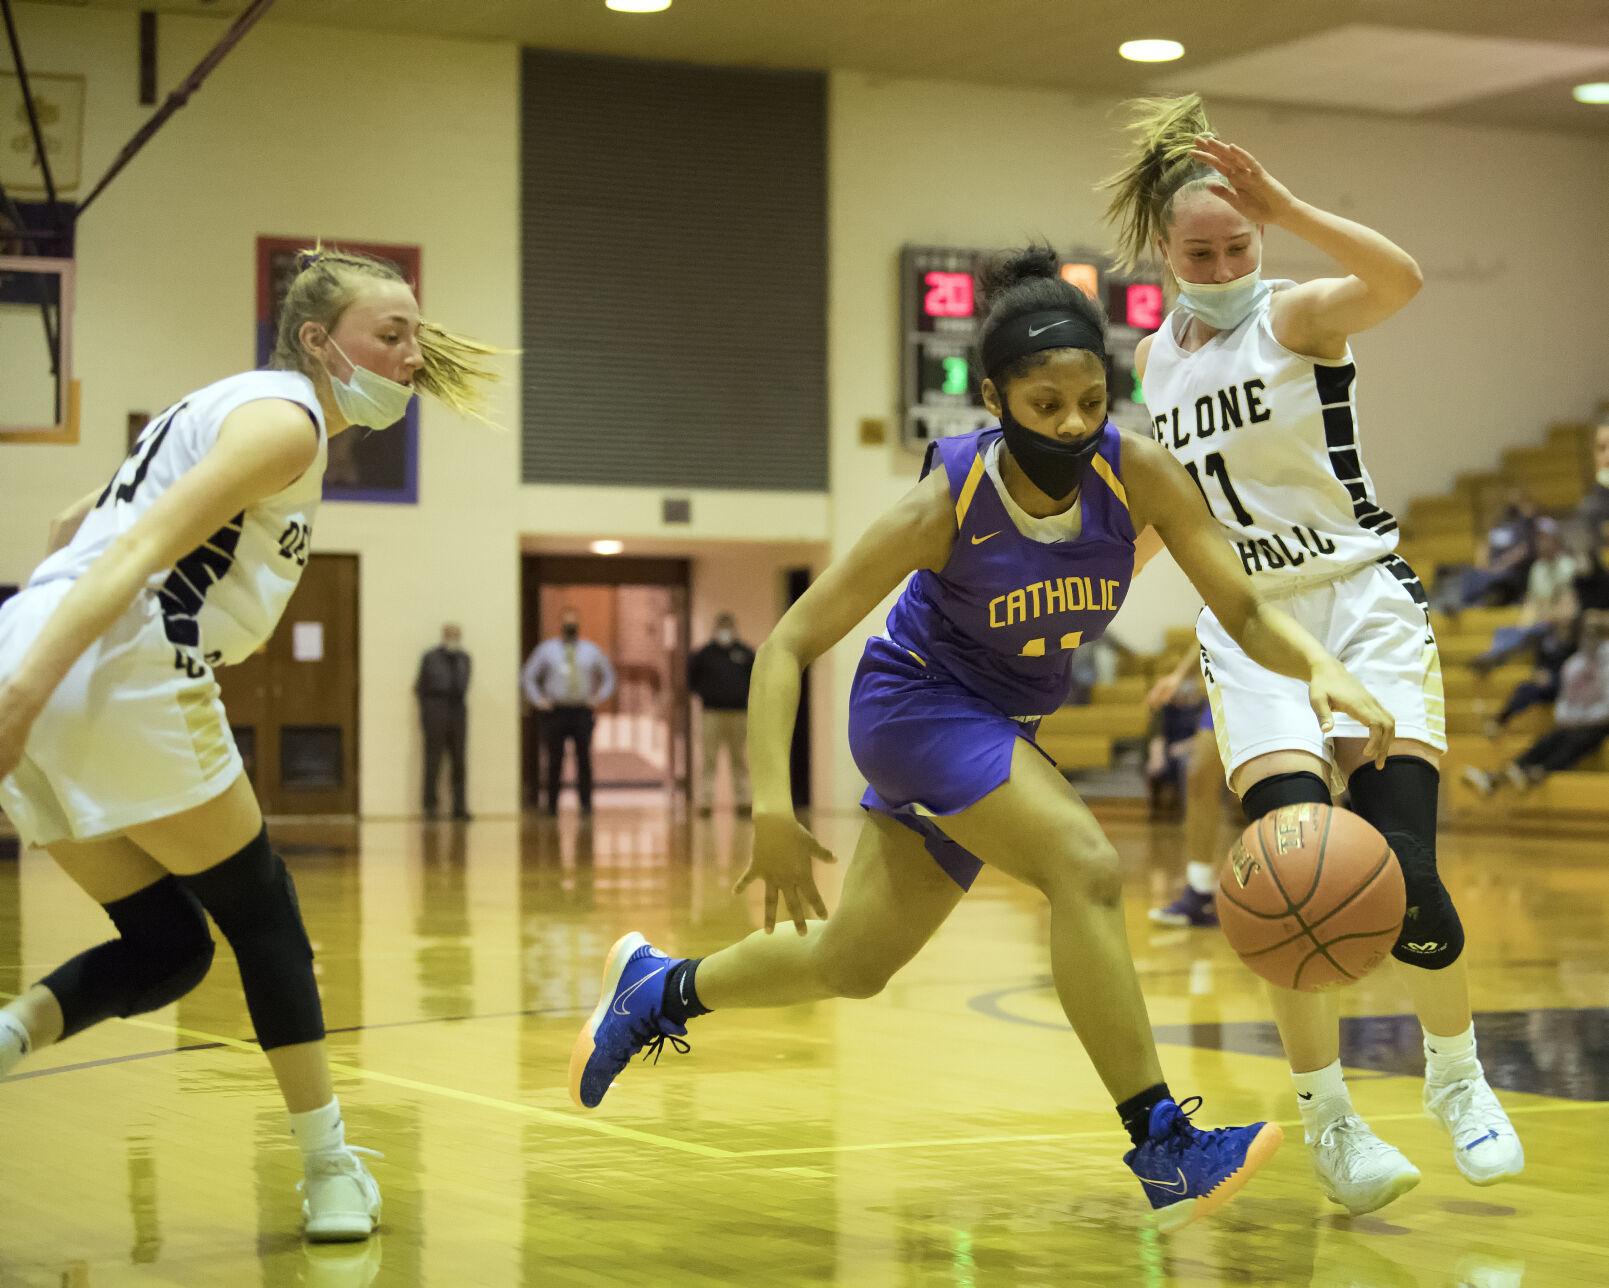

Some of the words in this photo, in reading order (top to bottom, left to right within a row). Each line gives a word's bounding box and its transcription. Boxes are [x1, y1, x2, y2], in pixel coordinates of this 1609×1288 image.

[1152, 379, 1271, 449] ELONE
[1237, 525, 1335, 576] HOLIC
[989, 577, 1120, 628] CATHOLIC
